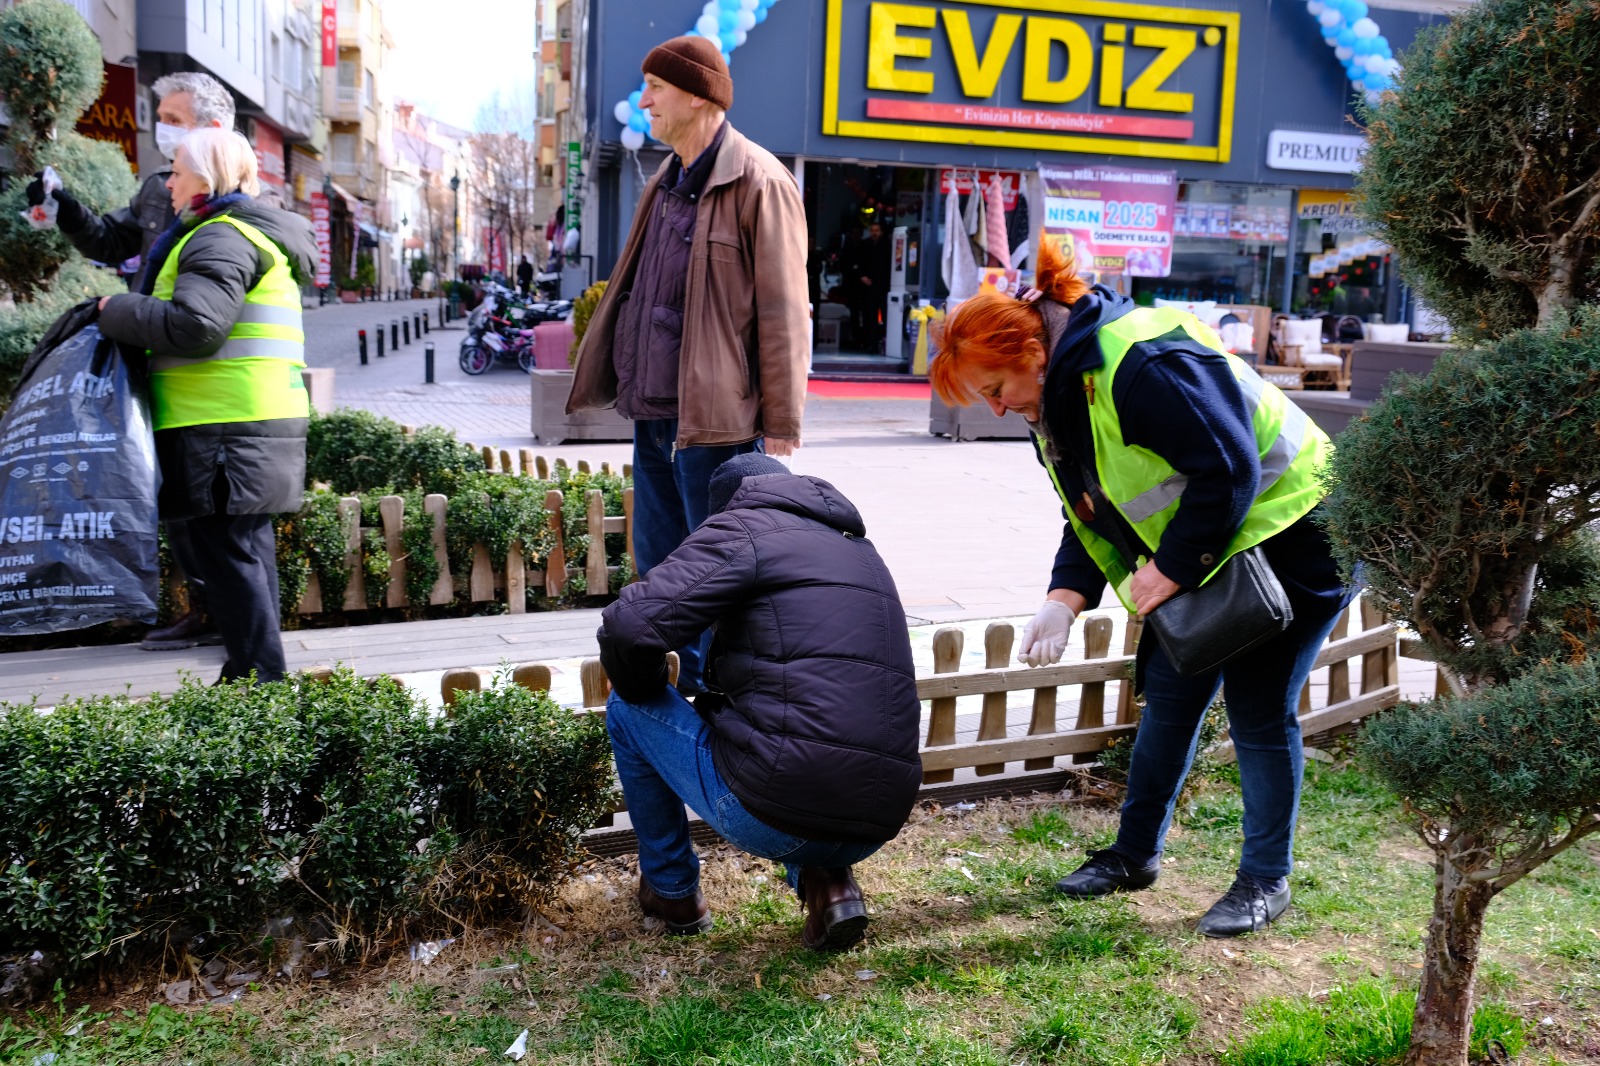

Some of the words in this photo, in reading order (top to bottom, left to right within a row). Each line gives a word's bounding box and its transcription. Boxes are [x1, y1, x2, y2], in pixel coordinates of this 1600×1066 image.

[1012, 111, 1032, 124] Her
[1048, 204, 1100, 224] NİSAN
[59, 512, 115, 540] ATIK
